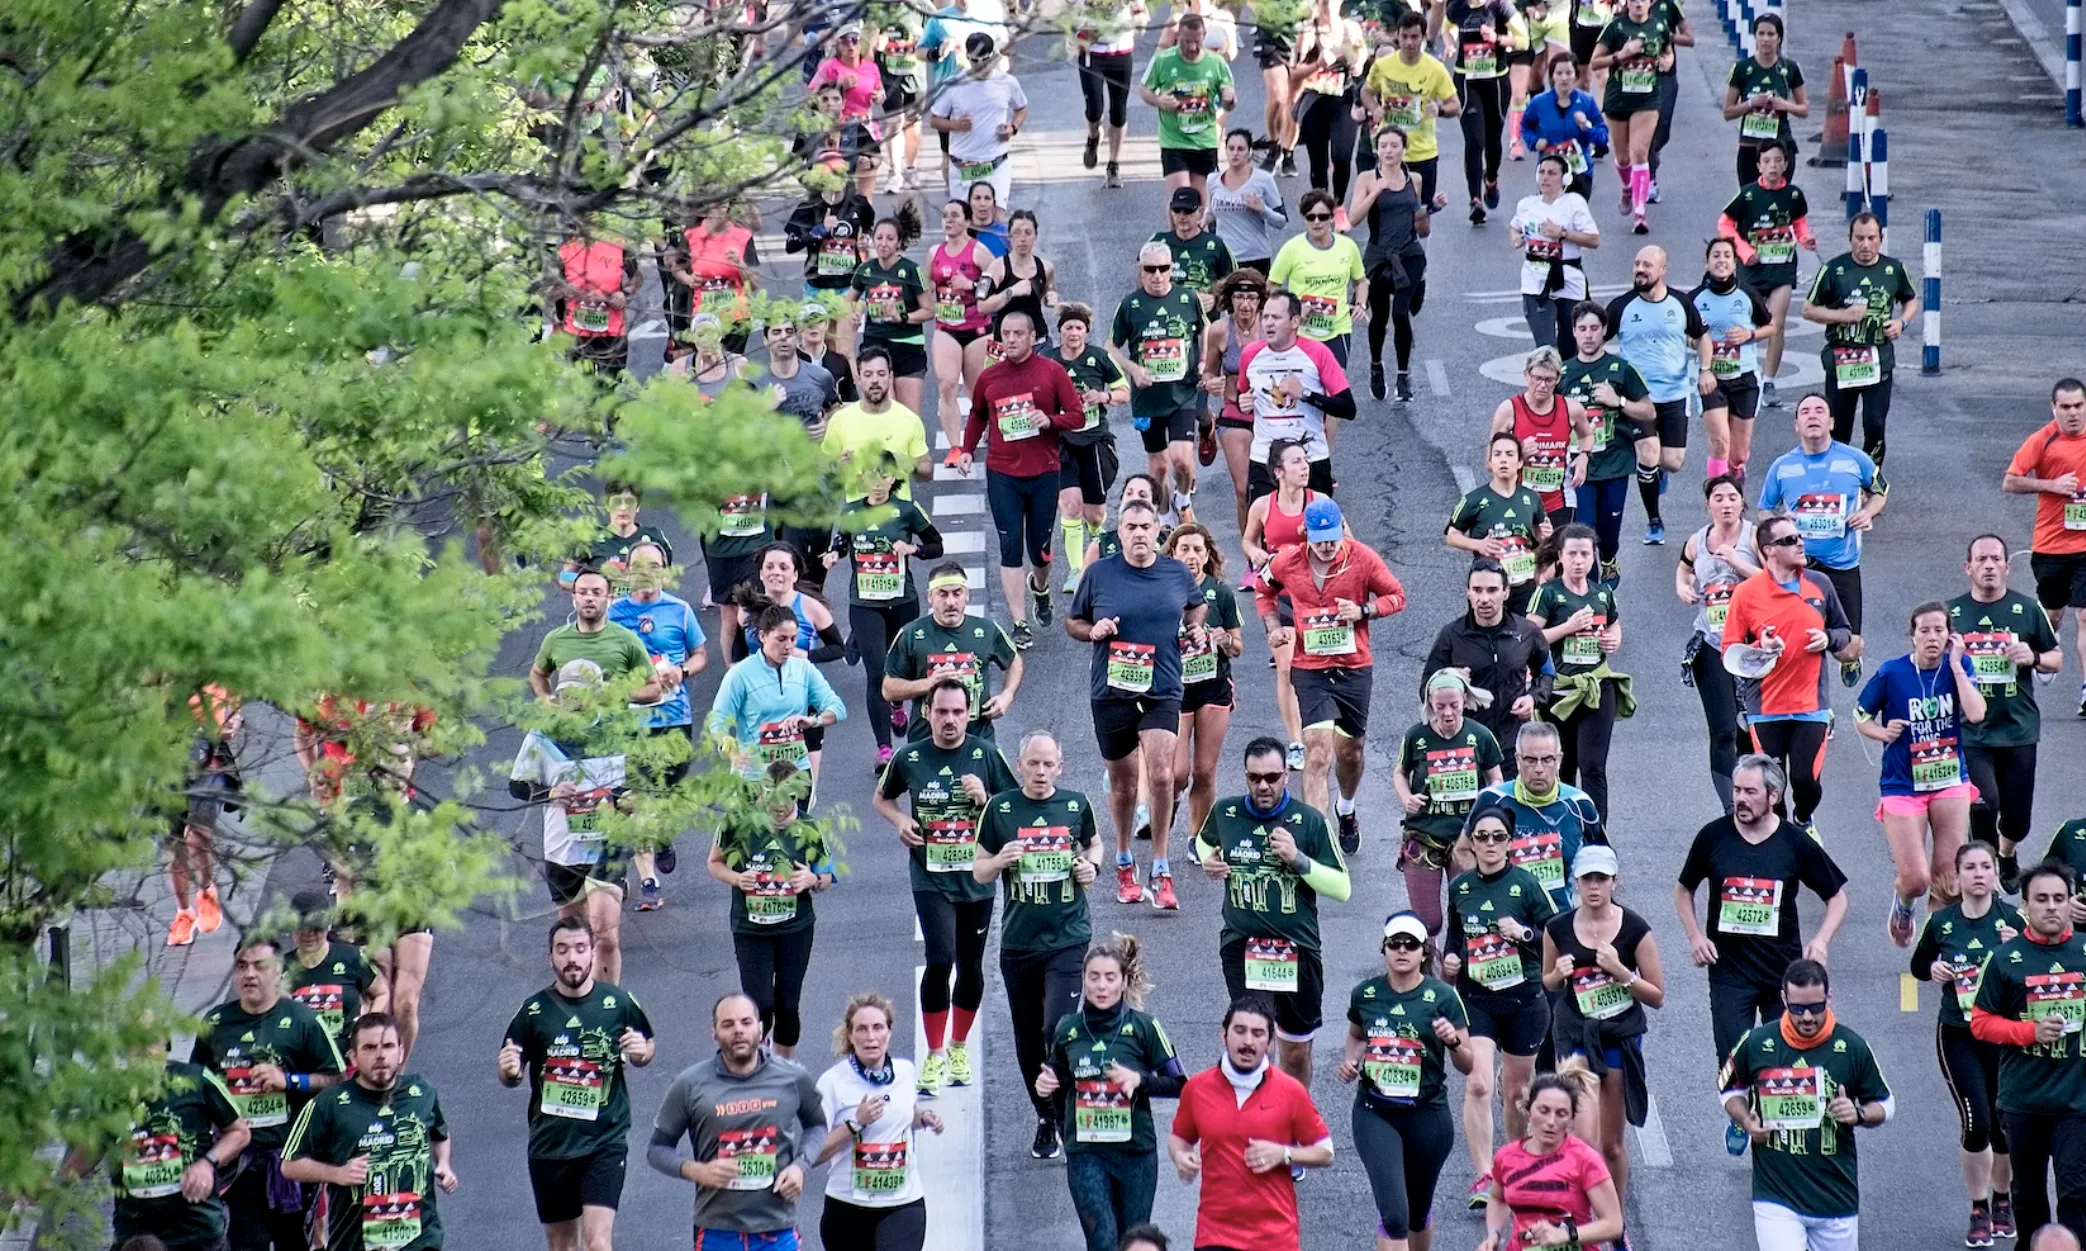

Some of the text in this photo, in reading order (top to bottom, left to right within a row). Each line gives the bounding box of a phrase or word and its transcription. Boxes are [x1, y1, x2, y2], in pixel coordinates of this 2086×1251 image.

[1910, 716, 1953, 736] FOR THE
[918, 791, 950, 800] MADRID
[1229, 849, 1261, 859] MADRID
[1737, 909, 1763, 923] 42572
[1367, 1028, 1397, 1038] MADRID
[547, 1046, 580, 1057] MADRID
[1779, 1102, 1808, 1116] 42659
[358, 1135, 395, 1148] MADRID
